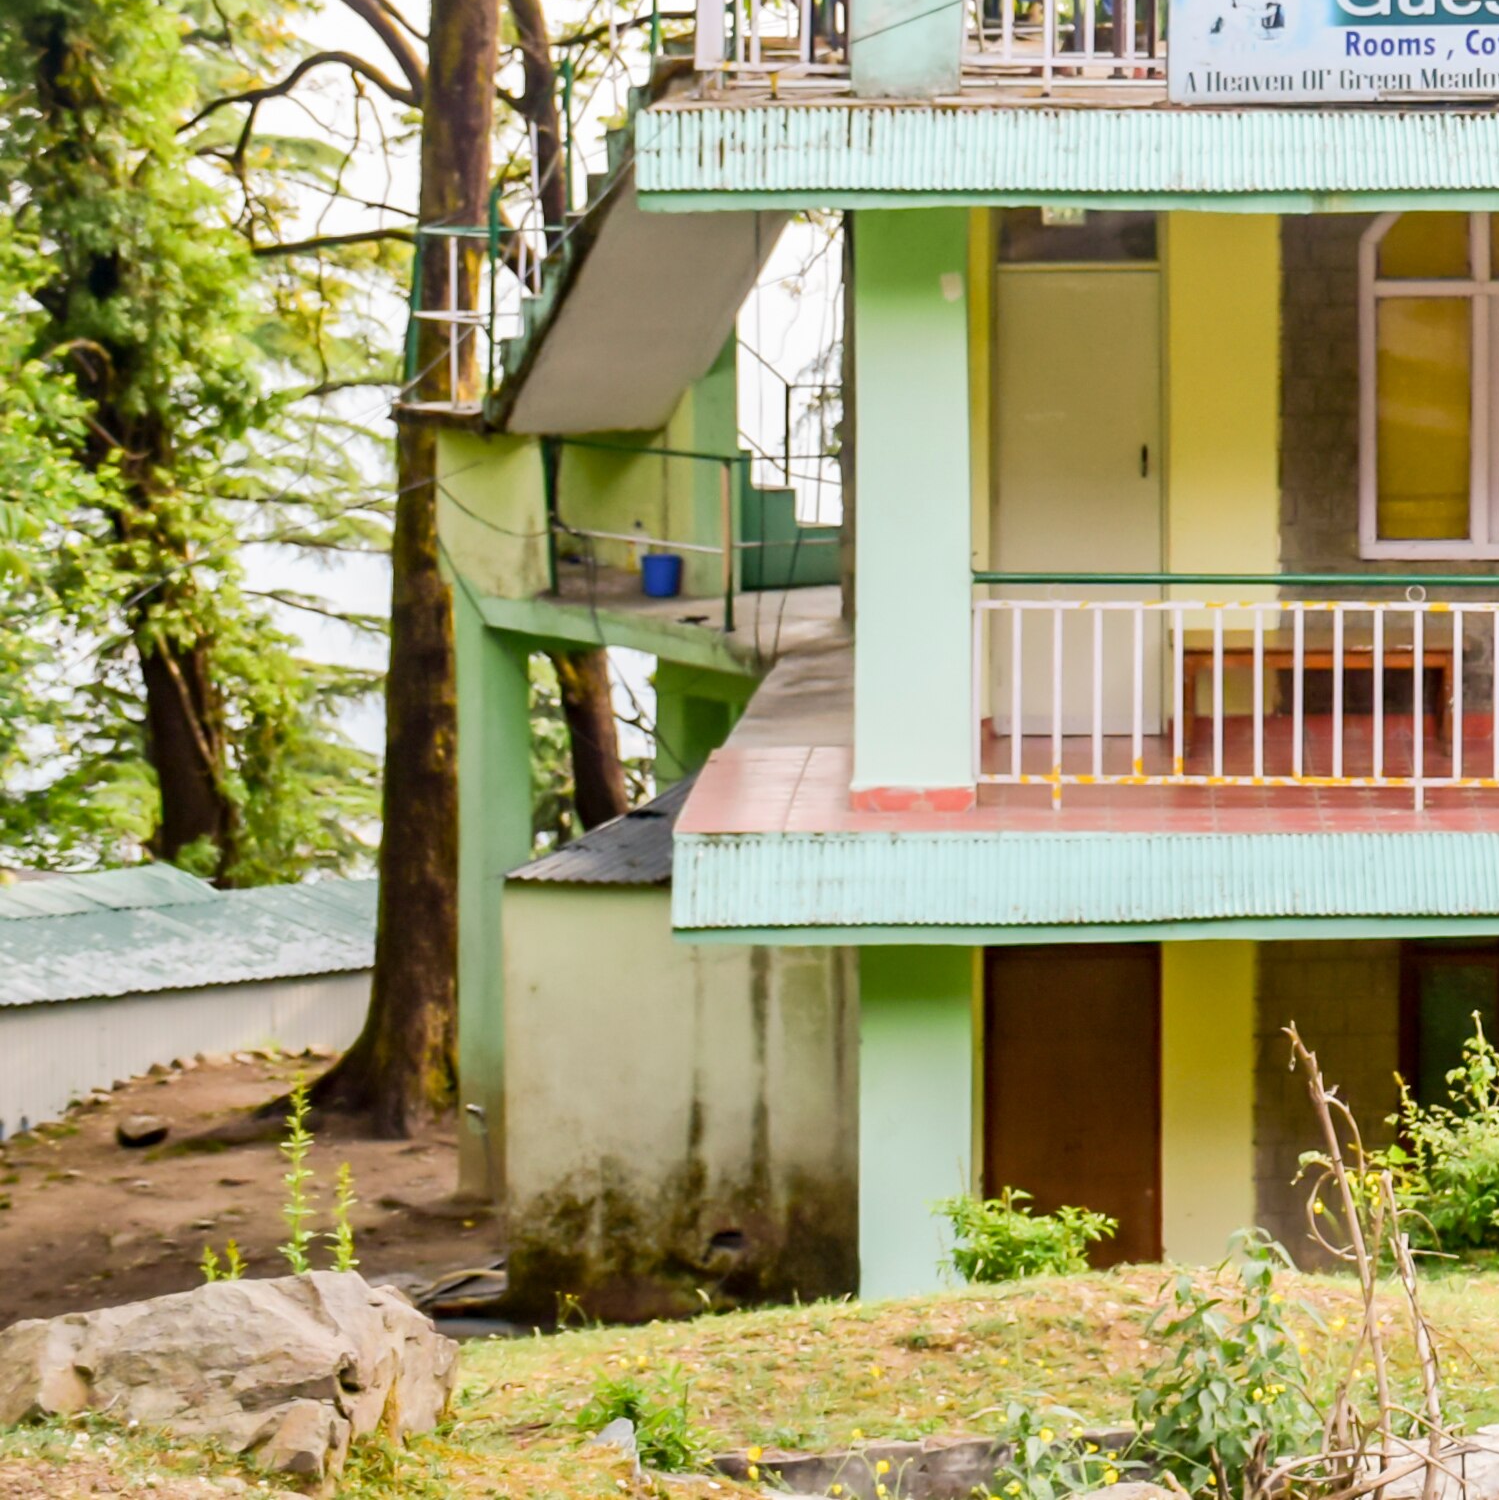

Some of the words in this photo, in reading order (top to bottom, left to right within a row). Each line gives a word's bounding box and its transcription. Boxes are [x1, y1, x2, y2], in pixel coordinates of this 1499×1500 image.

[1345, 30, 1436, 57] Rooms
[1185, 71, 1197, 93] A
[1206, 70, 1294, 93] Heaven
[1340, 68, 1412, 91] Green
